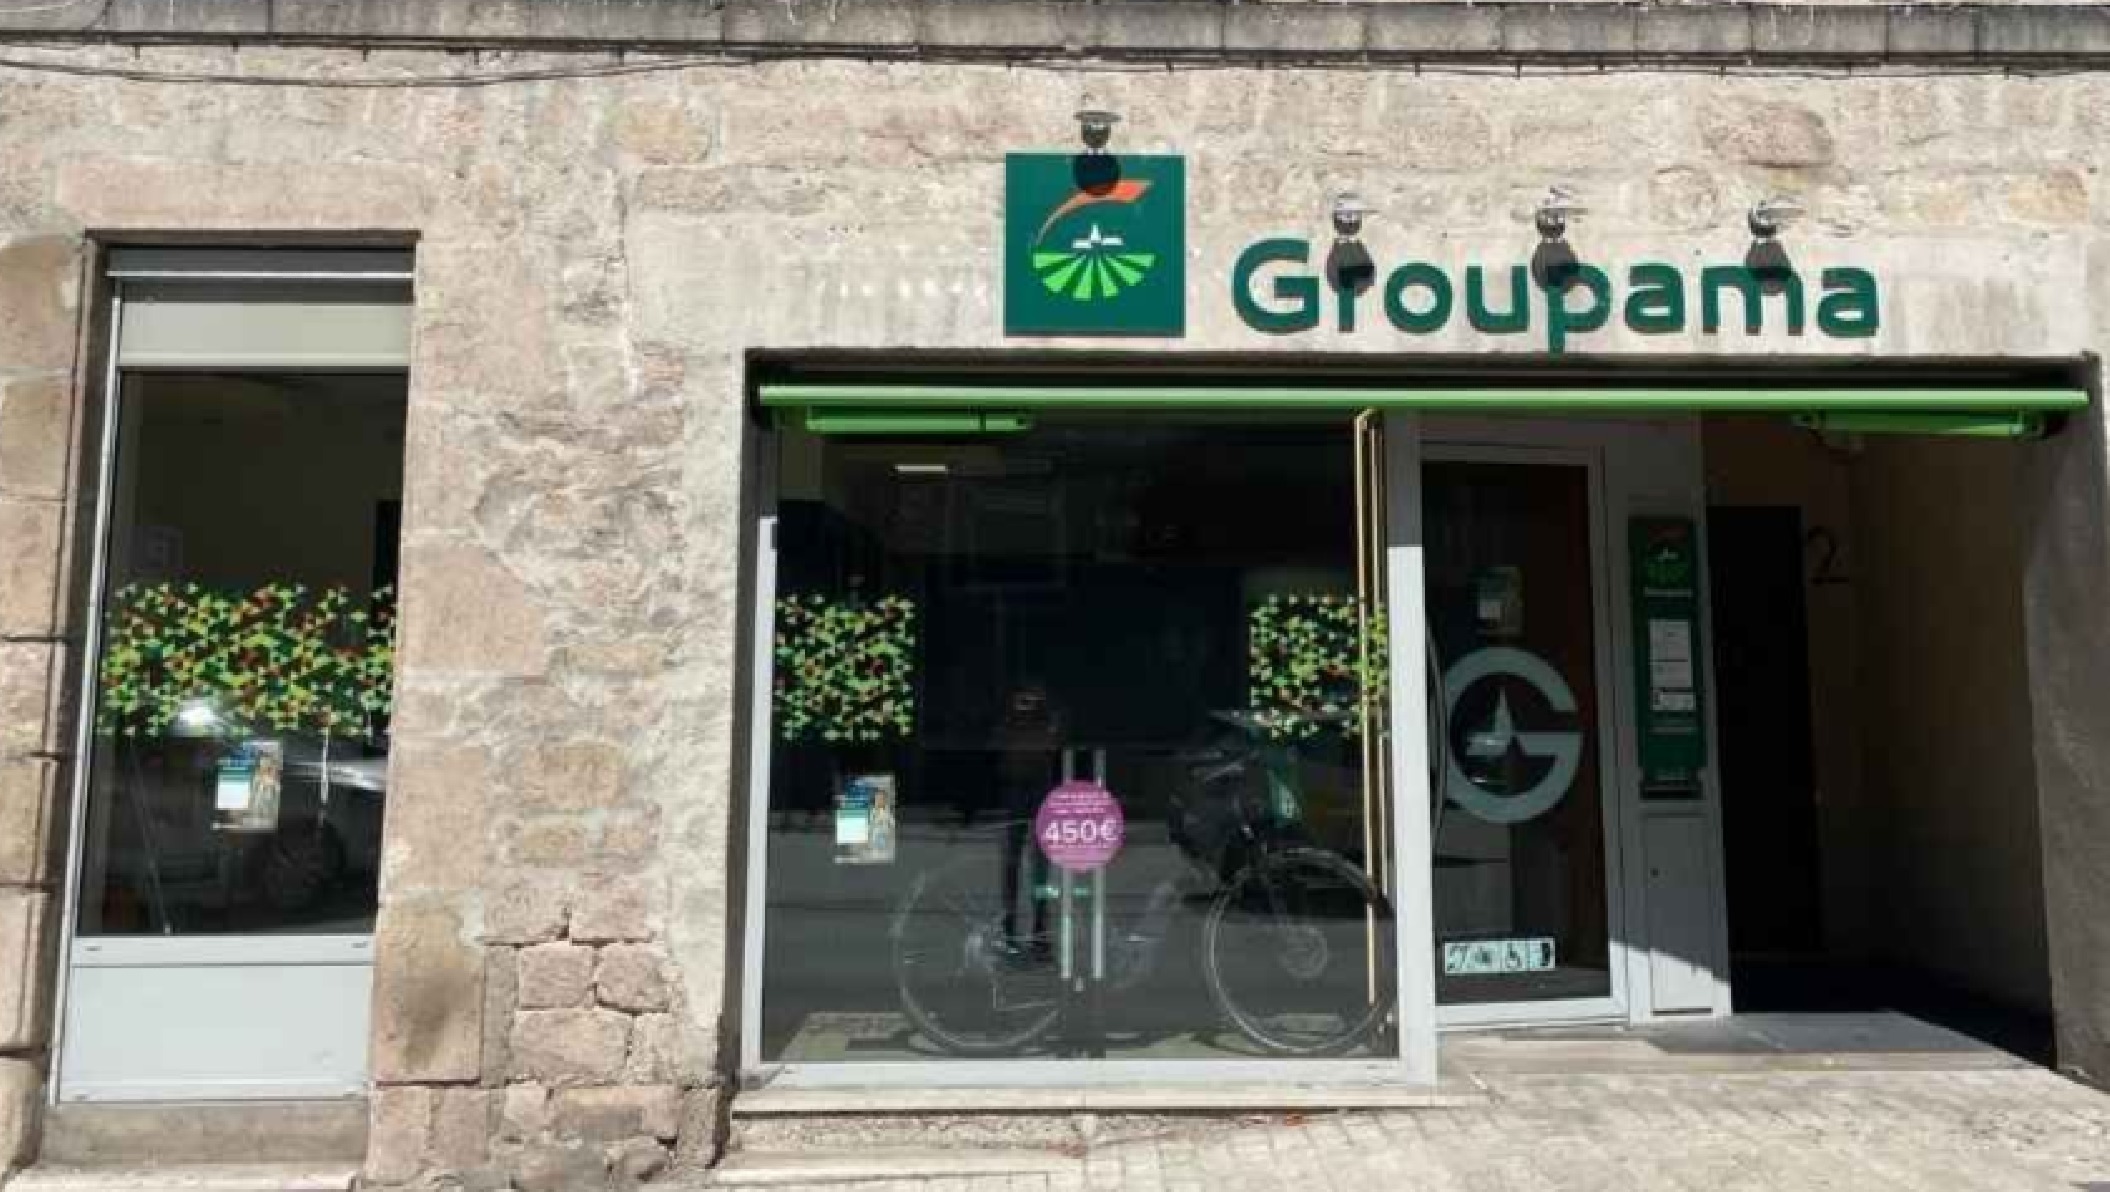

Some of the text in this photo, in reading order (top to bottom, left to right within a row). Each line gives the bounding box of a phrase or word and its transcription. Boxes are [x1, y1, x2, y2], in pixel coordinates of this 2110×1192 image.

[1231, 237, 1881, 355] Groupama
[1806, 525, 1849, 585] 2
[1043, 818, 1118, 844] 450€
